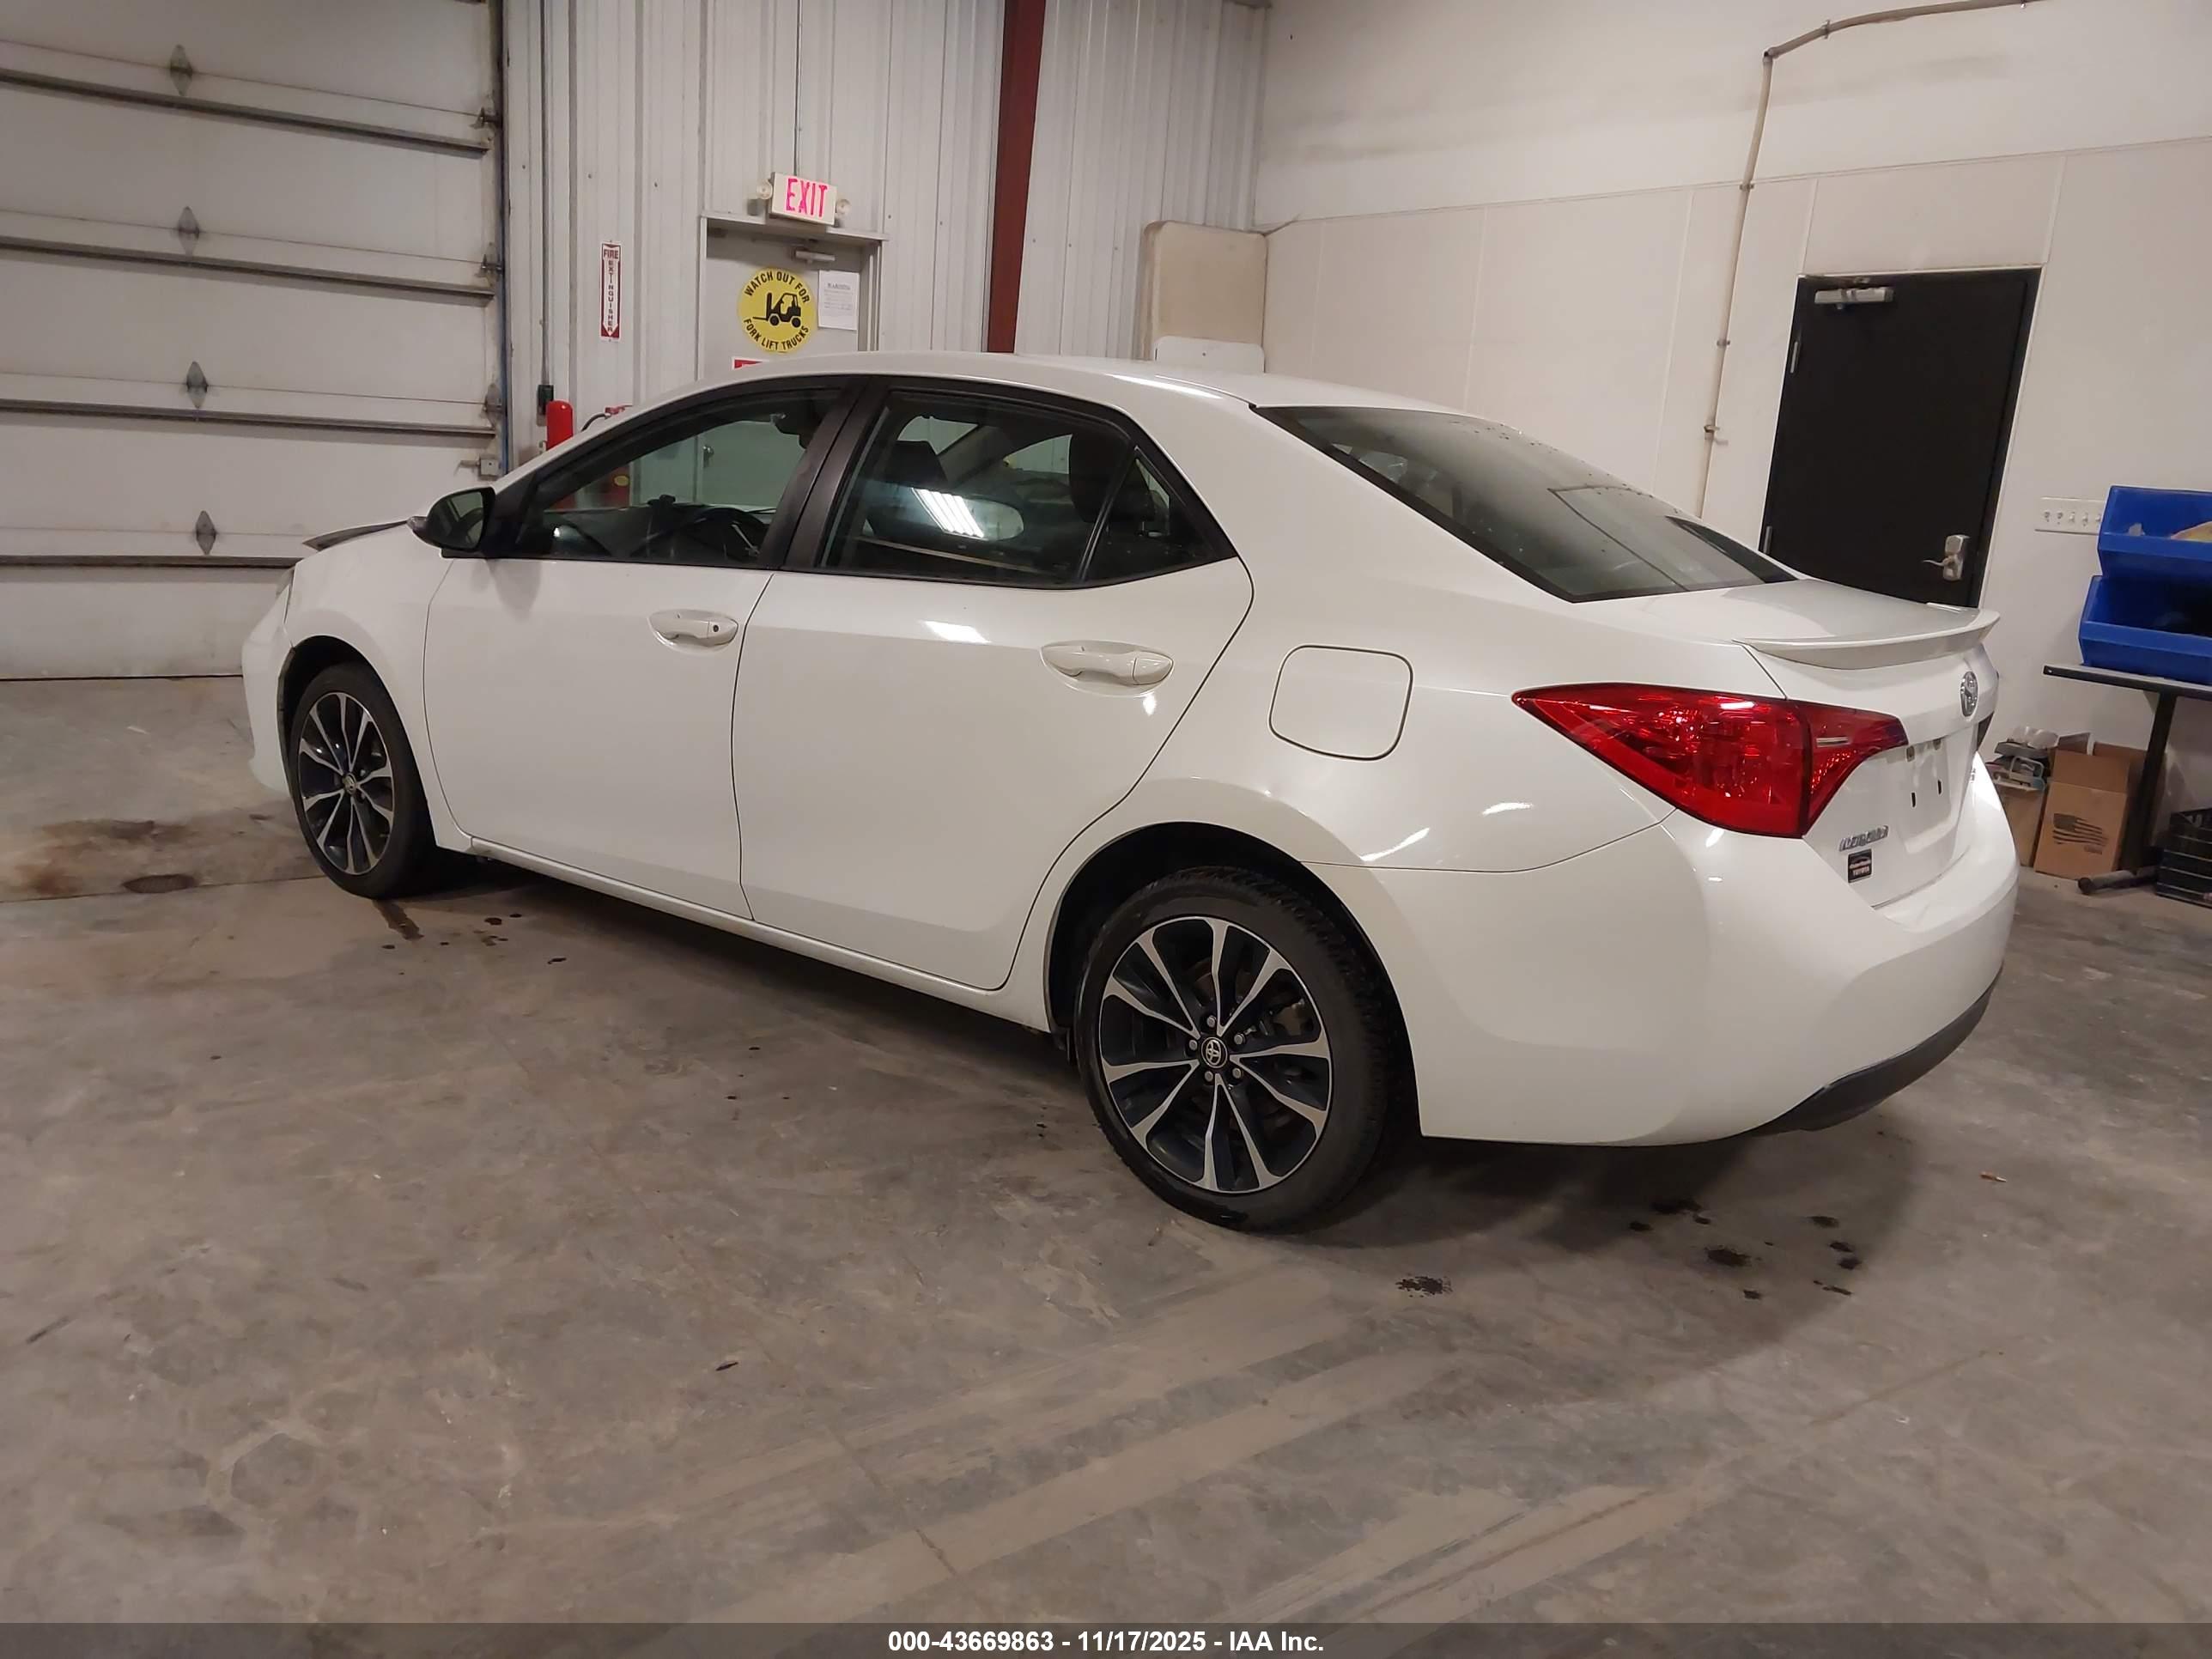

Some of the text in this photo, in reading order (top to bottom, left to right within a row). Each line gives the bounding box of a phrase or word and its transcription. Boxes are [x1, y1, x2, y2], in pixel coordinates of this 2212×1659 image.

[786, 178, 828, 217] EXIT
[603, 249, 618, 259] FIRE
[744, 270, 774, 296] WATCH
[776, 271, 795, 285] OUT
[794, 283, 811, 303] FOR
[744, 318, 809, 351] FORK LIFT TRUCKS
